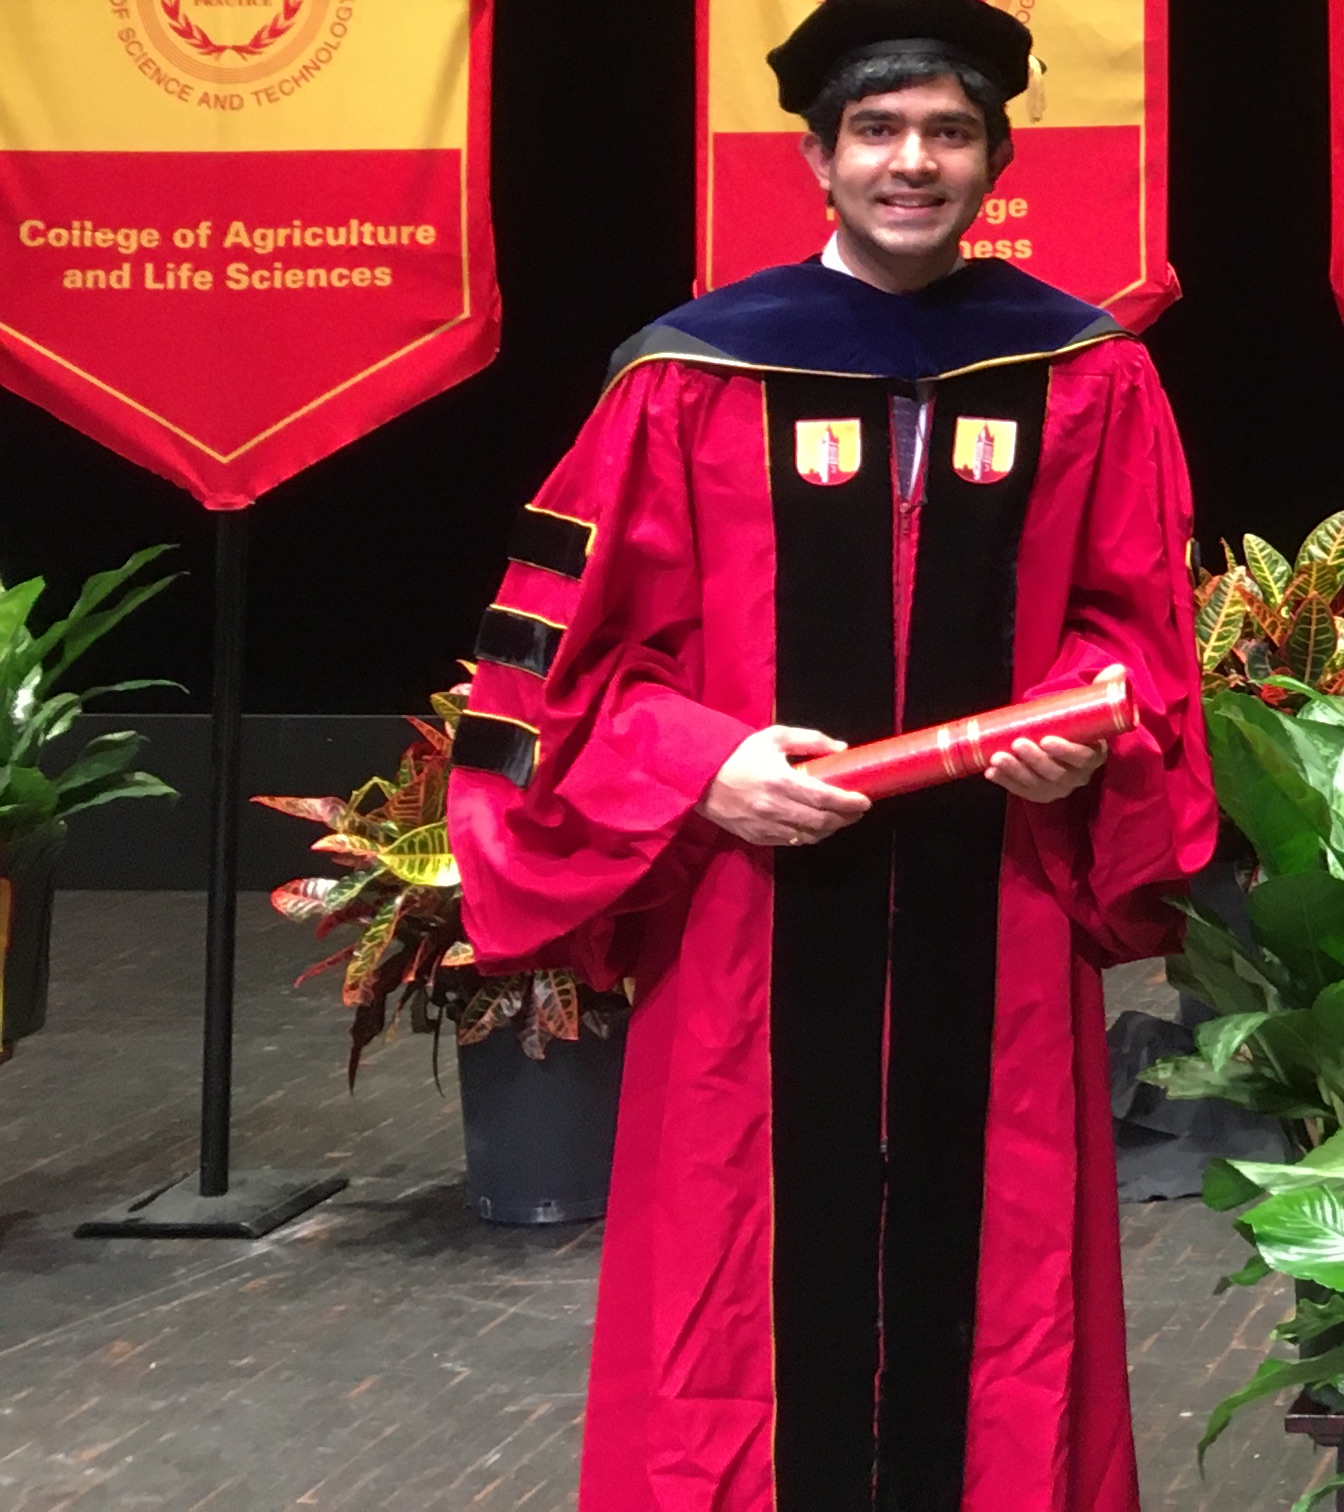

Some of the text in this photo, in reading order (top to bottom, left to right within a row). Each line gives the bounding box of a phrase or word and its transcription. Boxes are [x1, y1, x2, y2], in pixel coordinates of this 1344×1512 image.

[20, 219, 436, 254] College of Agriculture
[63, 262, 391, 290] and Life Sciences
